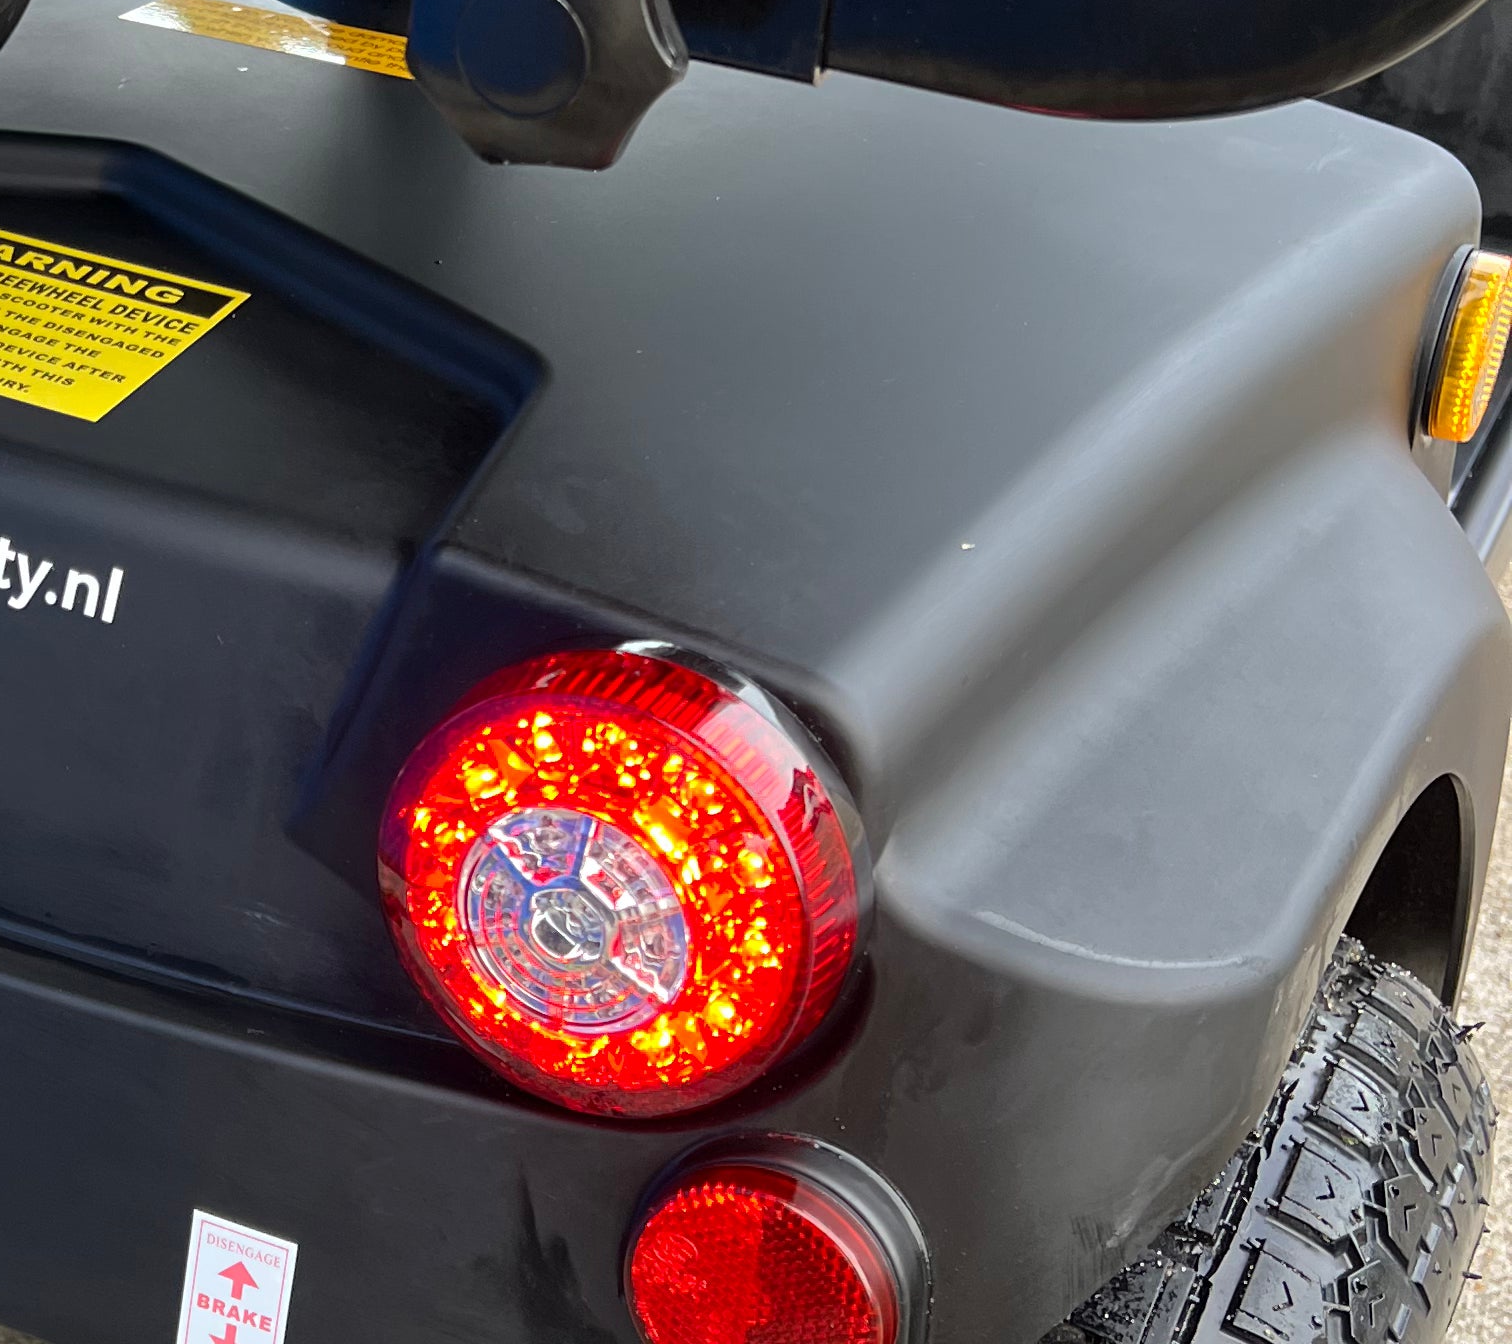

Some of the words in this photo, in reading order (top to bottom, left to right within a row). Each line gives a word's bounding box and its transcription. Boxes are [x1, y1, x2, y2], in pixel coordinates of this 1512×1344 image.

[4, 310, 42, 326] THE
[43, 321, 165, 359] DISENGAGED
[89, 316, 139, 335] WITH
[144, 330, 182, 347] THE
[108, 303, 200, 335] DEVICE
[63, 342, 102, 358] THE
[31, 368, 76, 386] THIS
[61, 361, 127, 384] AFTER
[206, 1232, 281, 1268] DISENGAGE
[196, 1293, 273, 1333] BRAKE
